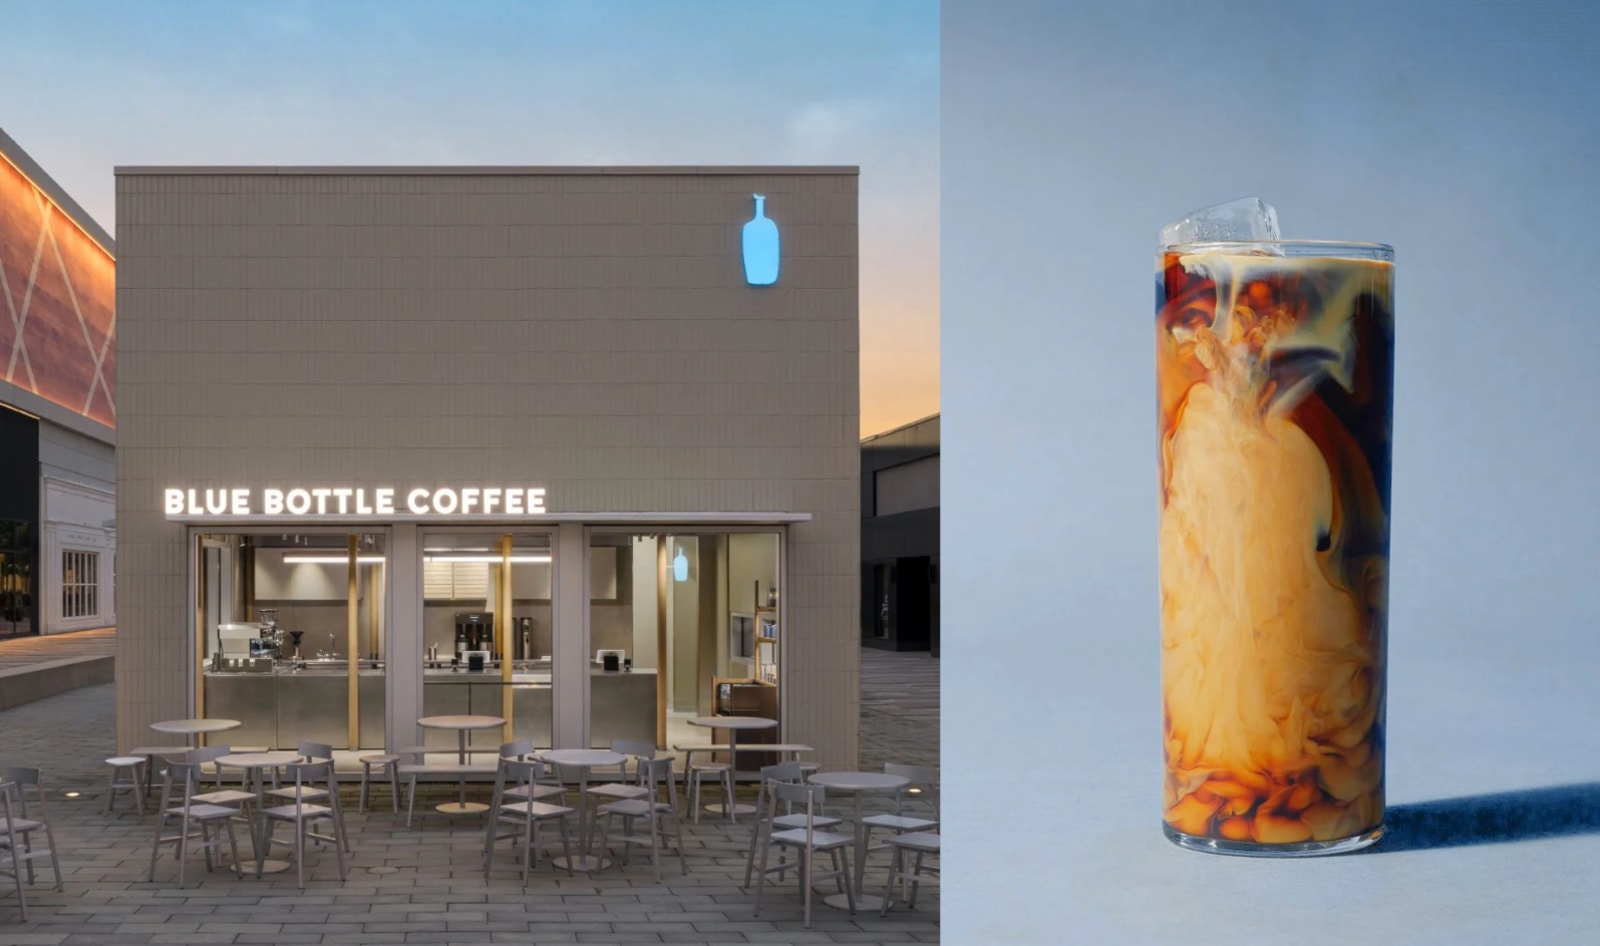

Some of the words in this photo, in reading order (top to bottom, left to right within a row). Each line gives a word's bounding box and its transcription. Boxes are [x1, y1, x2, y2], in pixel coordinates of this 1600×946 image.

[164, 488, 250, 515] BLUE
[264, 488, 395, 515] BOTTLE
[407, 488, 546, 515] COFFEE
